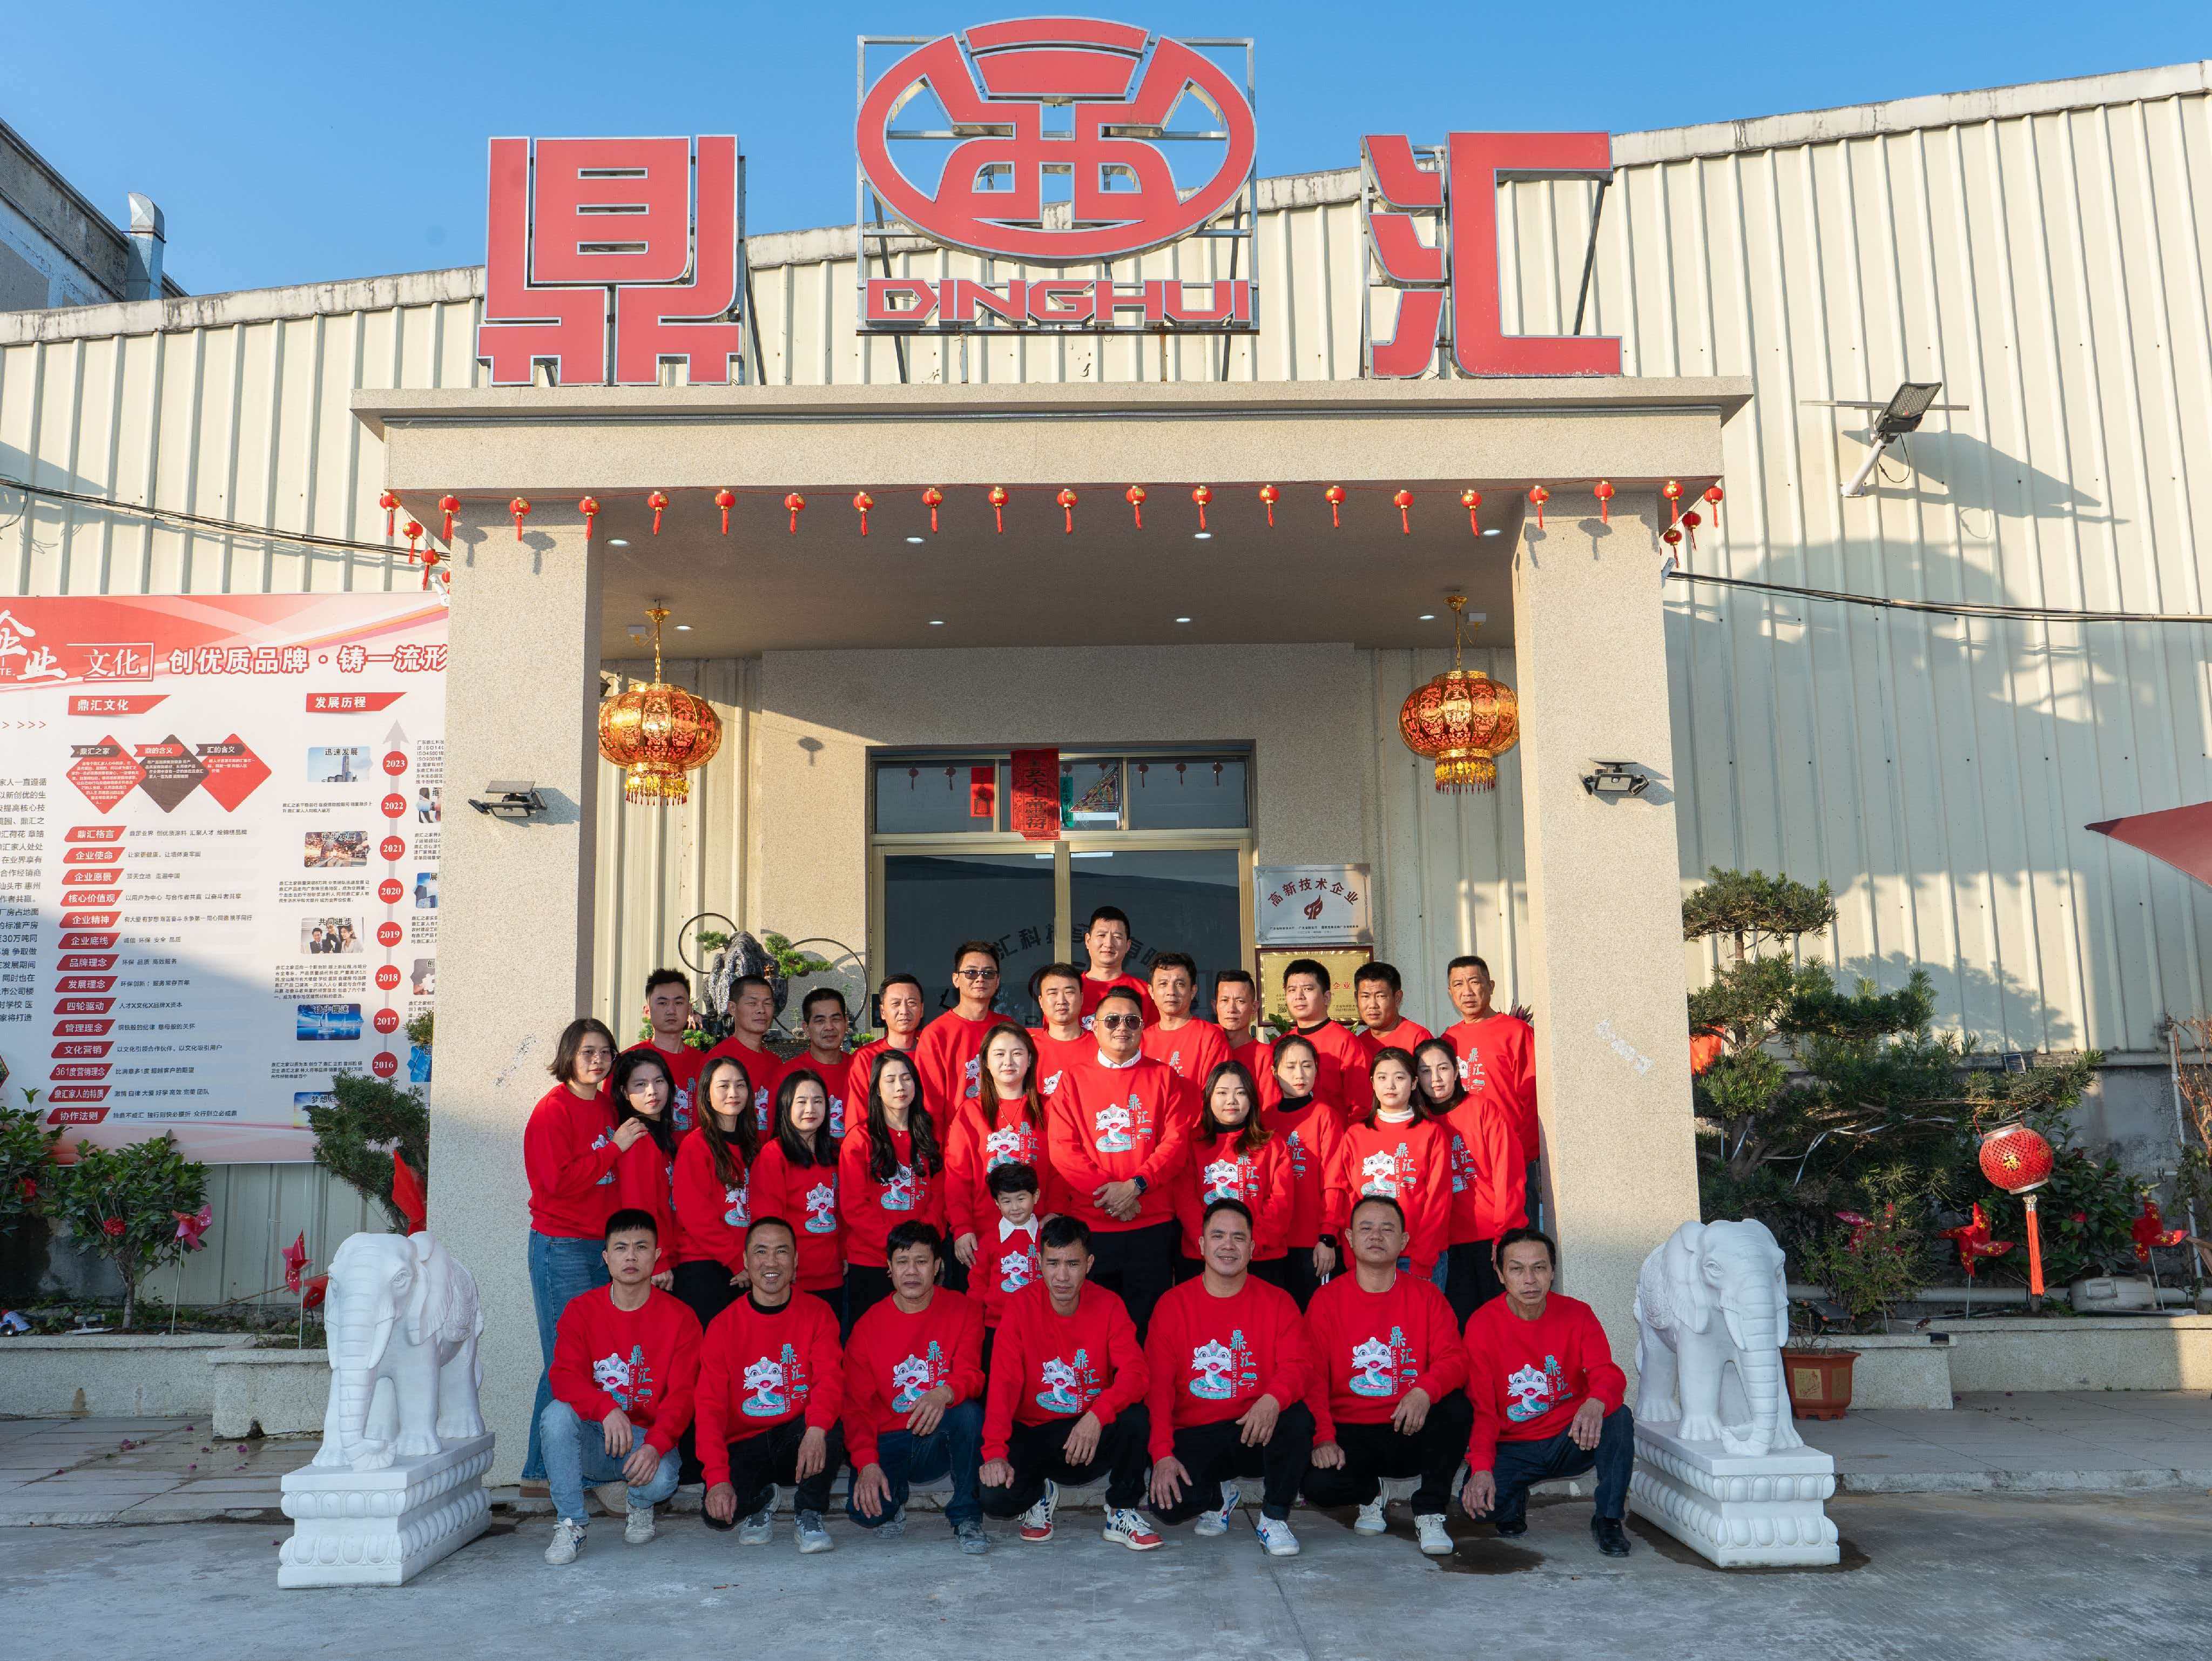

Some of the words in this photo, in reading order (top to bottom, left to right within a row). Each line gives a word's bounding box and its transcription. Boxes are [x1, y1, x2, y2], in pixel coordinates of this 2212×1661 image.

[478, 135, 742, 387] 鼎
[1361, 130, 1623, 380] 汇
[866, 278, 1252, 327] DINGHUI
[82, 649, 140, 676] 文化
[77, 700, 129, 711] 鼎汇文化
[315, 696, 366, 709] 发展历程
[325, 748, 358, 756] 迅速发展
[386, 759, 406, 768] 2023
[384, 802, 404, 810] 2022
[77, 830, 115, 838] 鼎汇格言
[382, 844, 402, 853] 2021
[76, 851, 113, 860] 企业使命
[1, 869, 41, 877] 合作经销商
[75, 873, 112, 882] 企业愿景
[381, 887, 401, 896] 2020
[1267, 877, 1359, 907] 高新技术企业
[69, 894, 116, 903] 核心价值观
[72, 916, 110, 924] 企业精神
[318, 918, 352, 926] 共同进步
[380, 930, 400, 939] 2019
[71, 937, 109, 946] 企业底线
[12, 947, 37, 956] 争取做
[69, 959, 107, 967] 品牌理念
[3, 974, 35, 982] 同时也在
[378, 973, 399, 982] 2018
[68, 980, 106, 989] 发展理念
[66, 1002, 104, 1011] 四轮驱动
[314, 1005, 349, 1014] 稳步提速
[376, 1017, 396, 1026] 2017
[65, 1024, 103, 1033] 管理理念
[64, 1045, 102, 1055] 文化营销
[374, 1060, 394, 1069] 2016
[56, 1067, 105, 1077] 361度营销理念
[55, 1089, 104, 1099] 鼎汇家人的特质
[60, 1111, 98, 1121] 协作法则
[1229, 1329, 1256, 1367] 鼎汇
[1388, 1326, 1417, 1364] 鼎汇
[628, 1344, 653, 1383] 鼎汇
[780, 1343, 806, 1381] 鼎汇
[1071, 1348, 1100, 1384] 鼎汇
